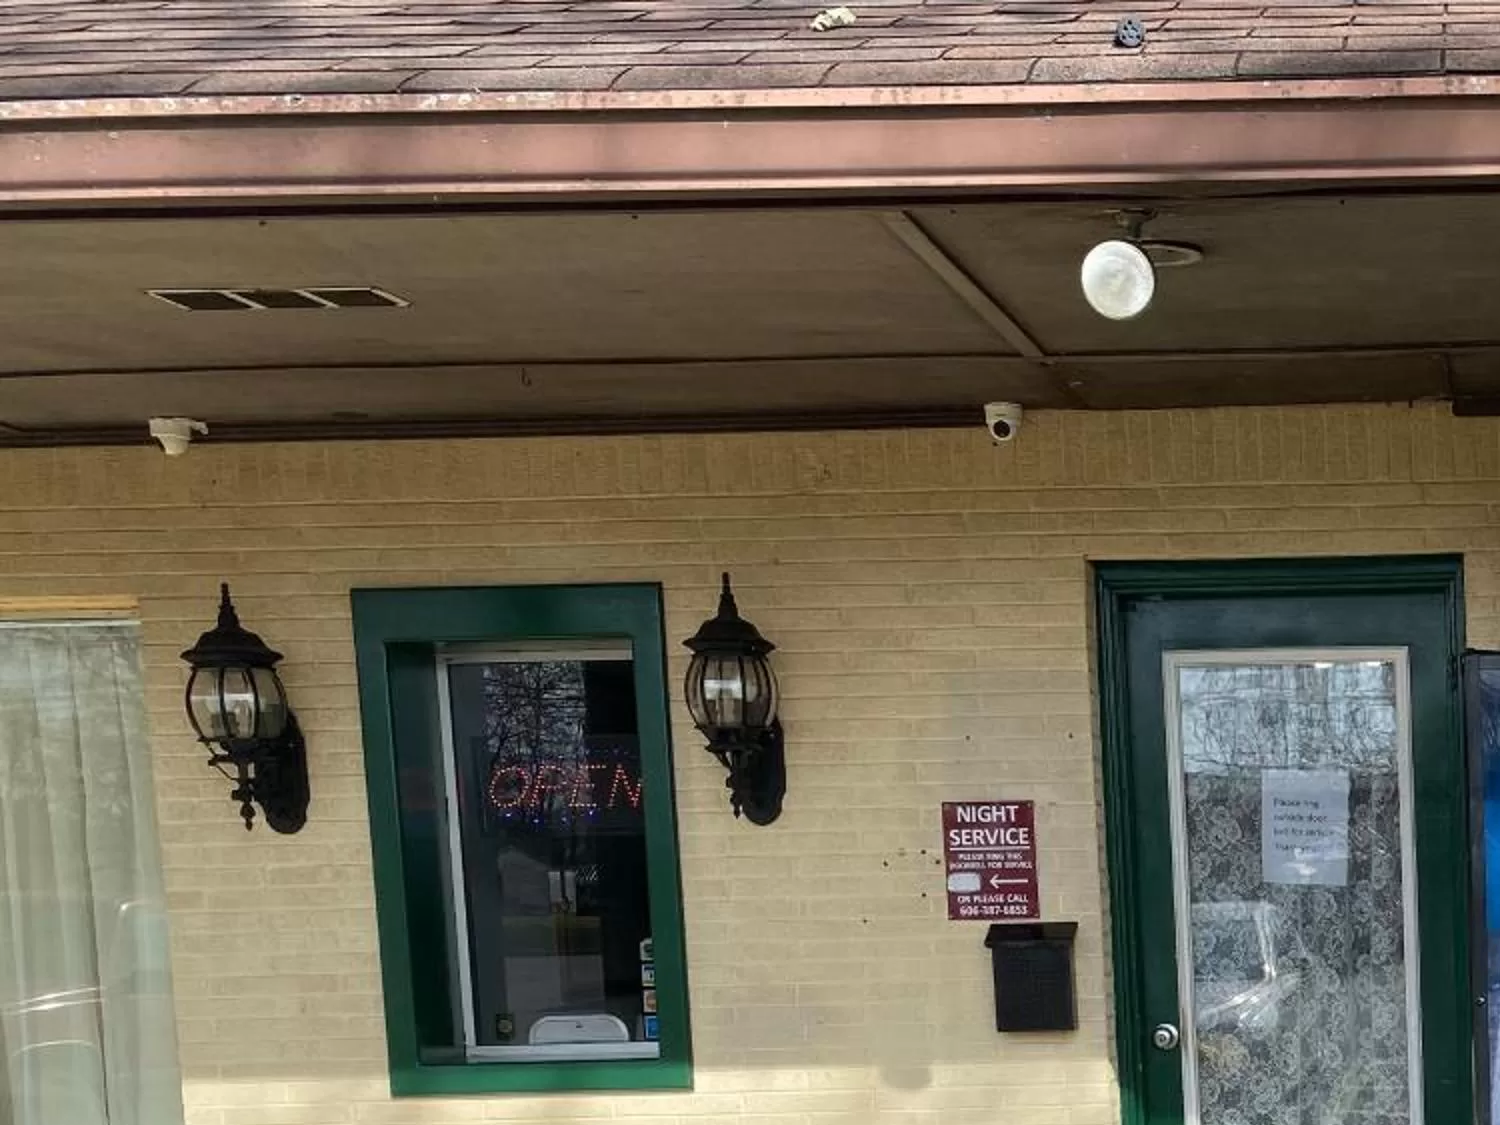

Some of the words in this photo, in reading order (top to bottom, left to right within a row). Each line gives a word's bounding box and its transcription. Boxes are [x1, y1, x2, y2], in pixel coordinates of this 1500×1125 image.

[488, 763, 644, 808] OPEN
[957, 805, 1020, 823] NIGHT
[949, 828, 1030, 846] SERVICE
[987, 861, 1002, 869] FOR
[957, 895, 971, 904] OR
[973, 894, 1004, 903] PLEASE
[1007, 893, 1028, 903] CALL
